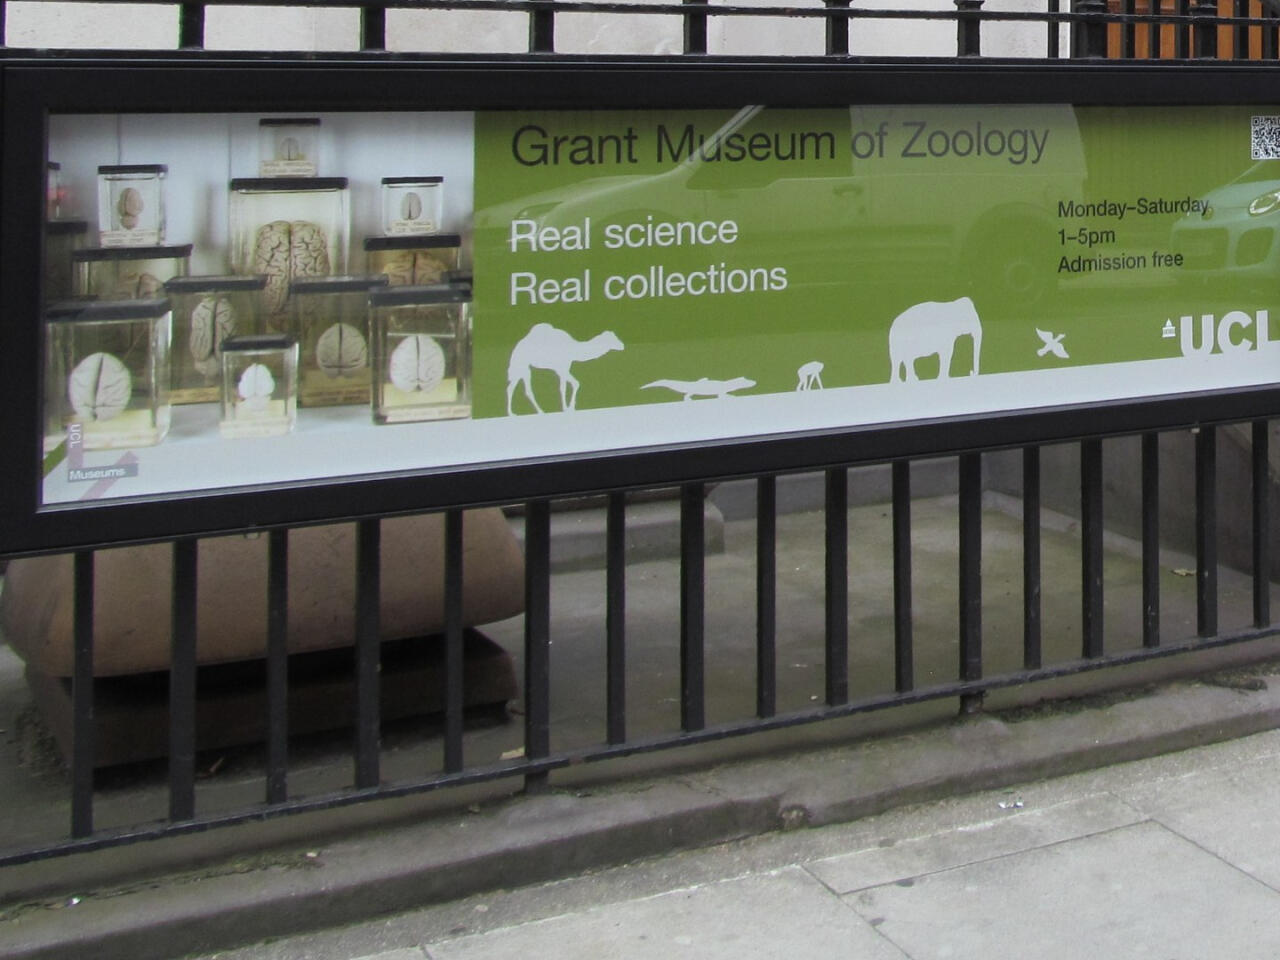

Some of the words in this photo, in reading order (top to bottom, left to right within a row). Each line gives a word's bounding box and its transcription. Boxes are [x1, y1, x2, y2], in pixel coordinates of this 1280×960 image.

[512, 124, 638, 166] Grant
[656, 123, 836, 163] Museum
[851, 121, 888, 160] of
[901, 121, 1049, 165] Zoology
[510, 217, 591, 253] Real
[604, 215, 739, 249] science
[1058, 253, 1147, 273] Admission
[1152, 251, 1185, 268] free
[510, 269, 591, 305] Real
[604, 262, 788, 300] collections
[70, 423, 81, 448] UCL
[69, 467, 126, 481] Museums
